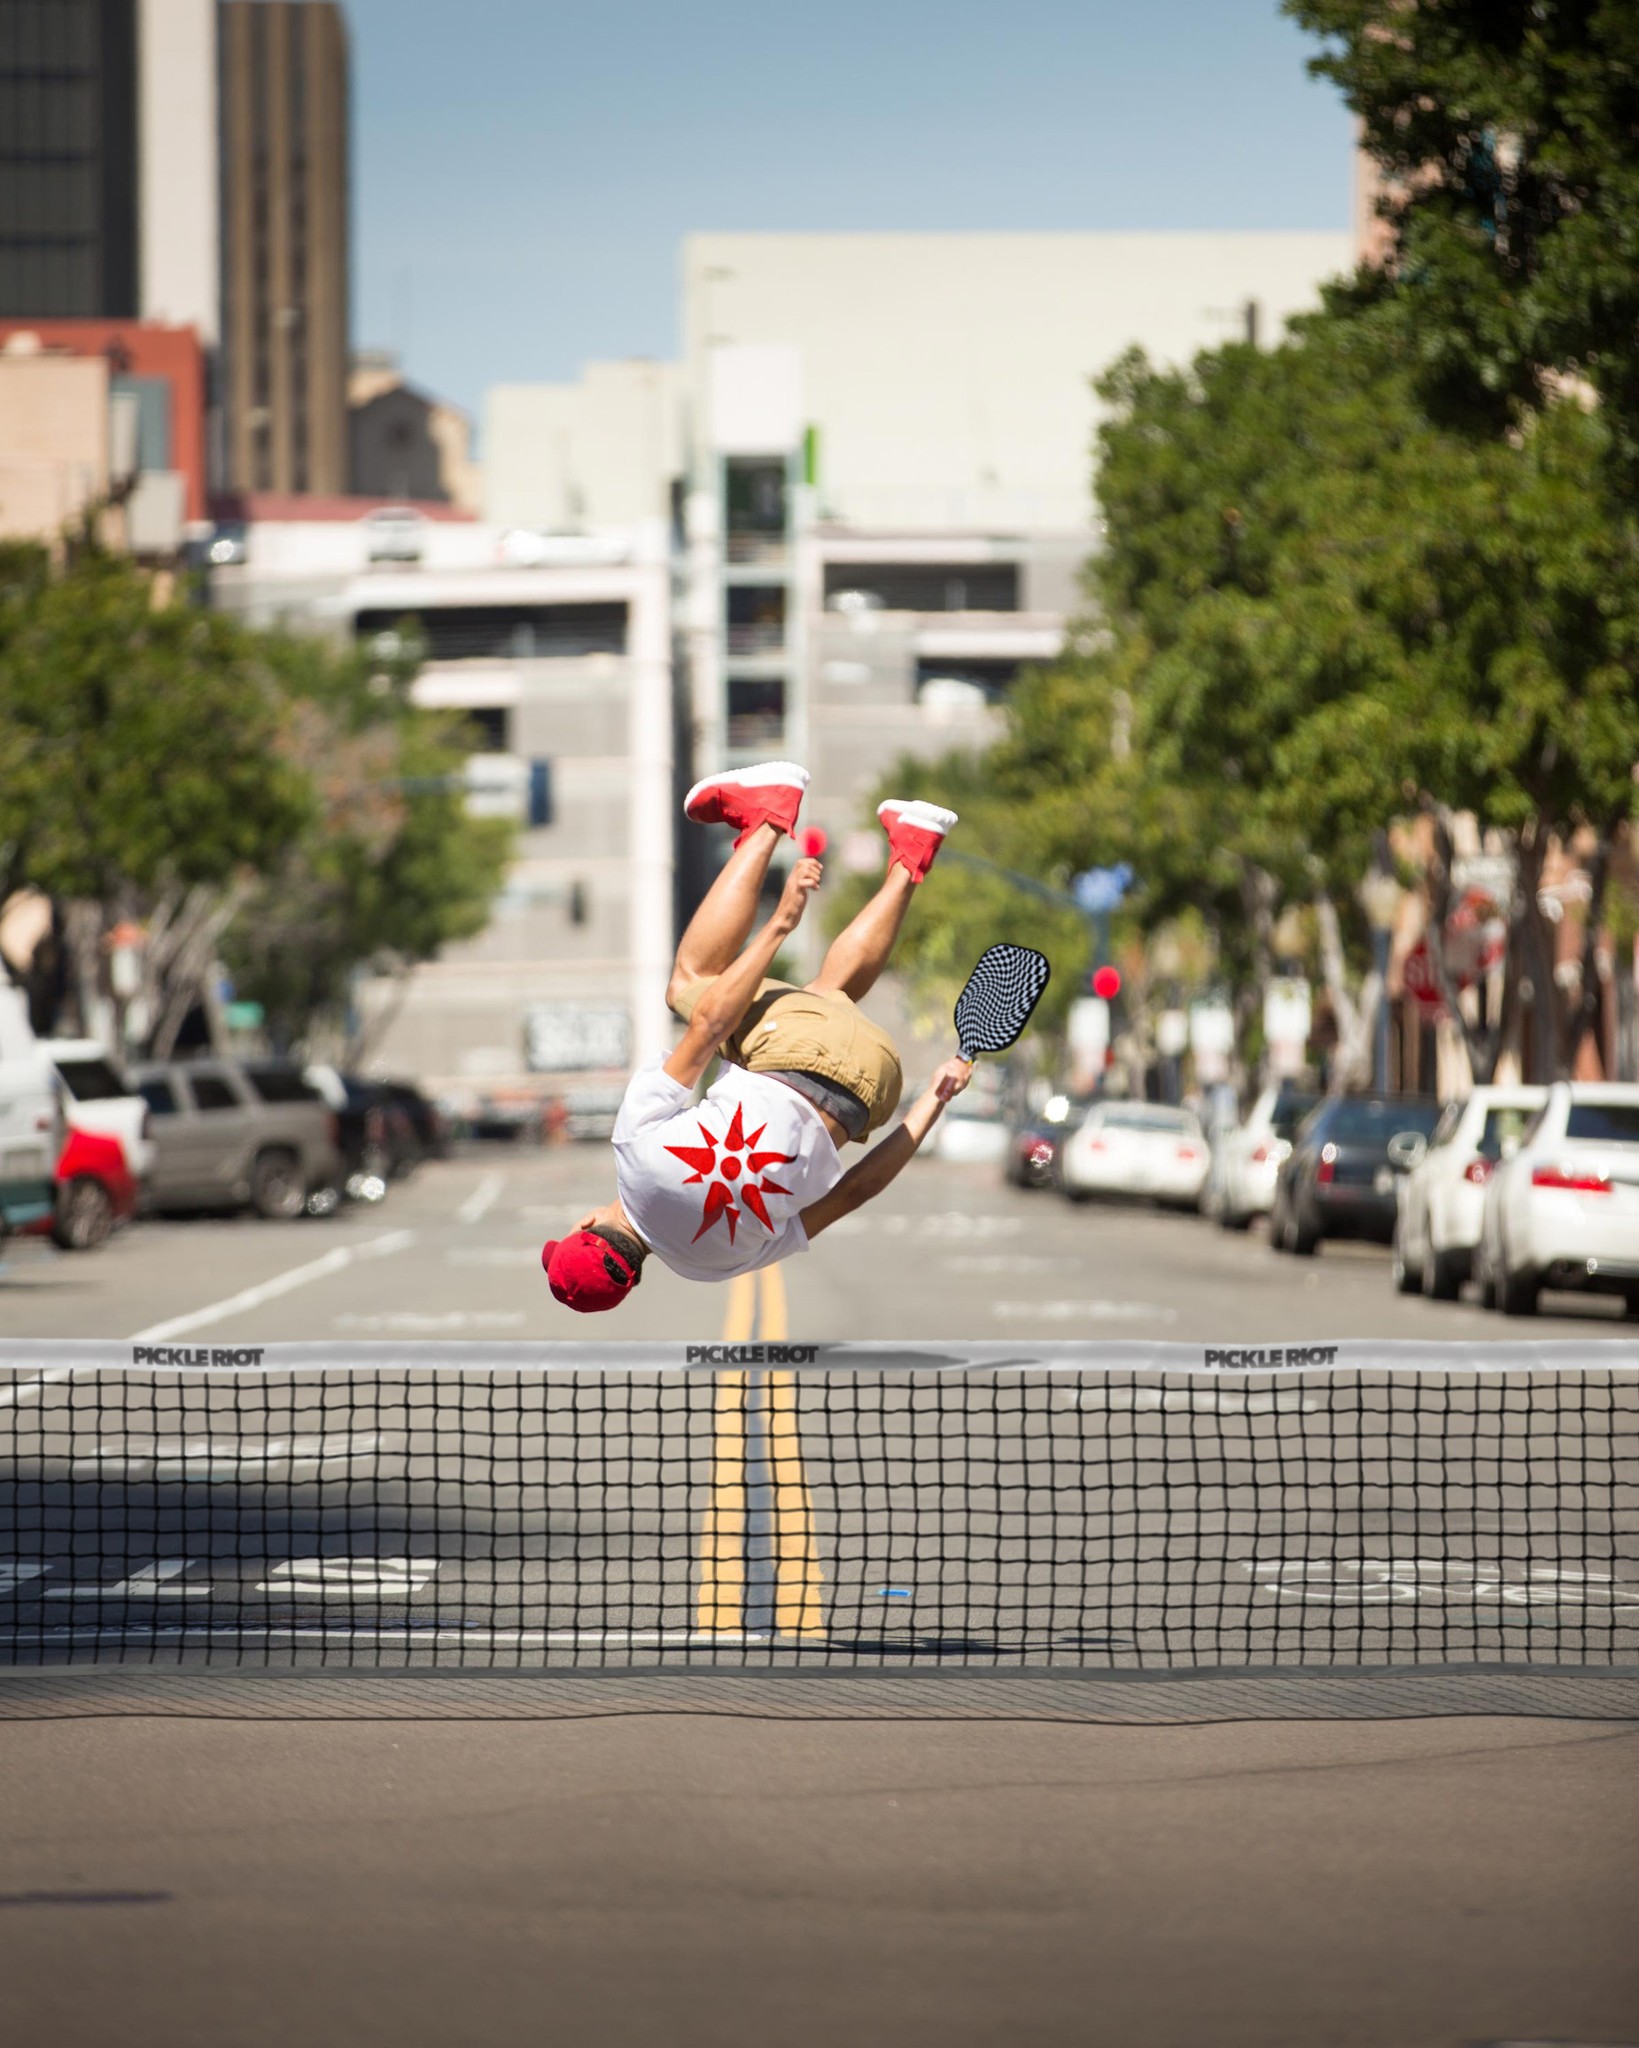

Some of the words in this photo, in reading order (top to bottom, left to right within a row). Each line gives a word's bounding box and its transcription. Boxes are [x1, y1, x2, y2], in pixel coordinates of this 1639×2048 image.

[133, 1346, 209, 1366] PICKLE
[211, 1348, 264, 1367] RIOT
[686, 1345, 764, 1363] PICKLE
[767, 1345, 819, 1364] RIOT
[1204, 1349, 1283, 1368] PICKLE
[1286, 1346, 1338, 1367] RIOT
